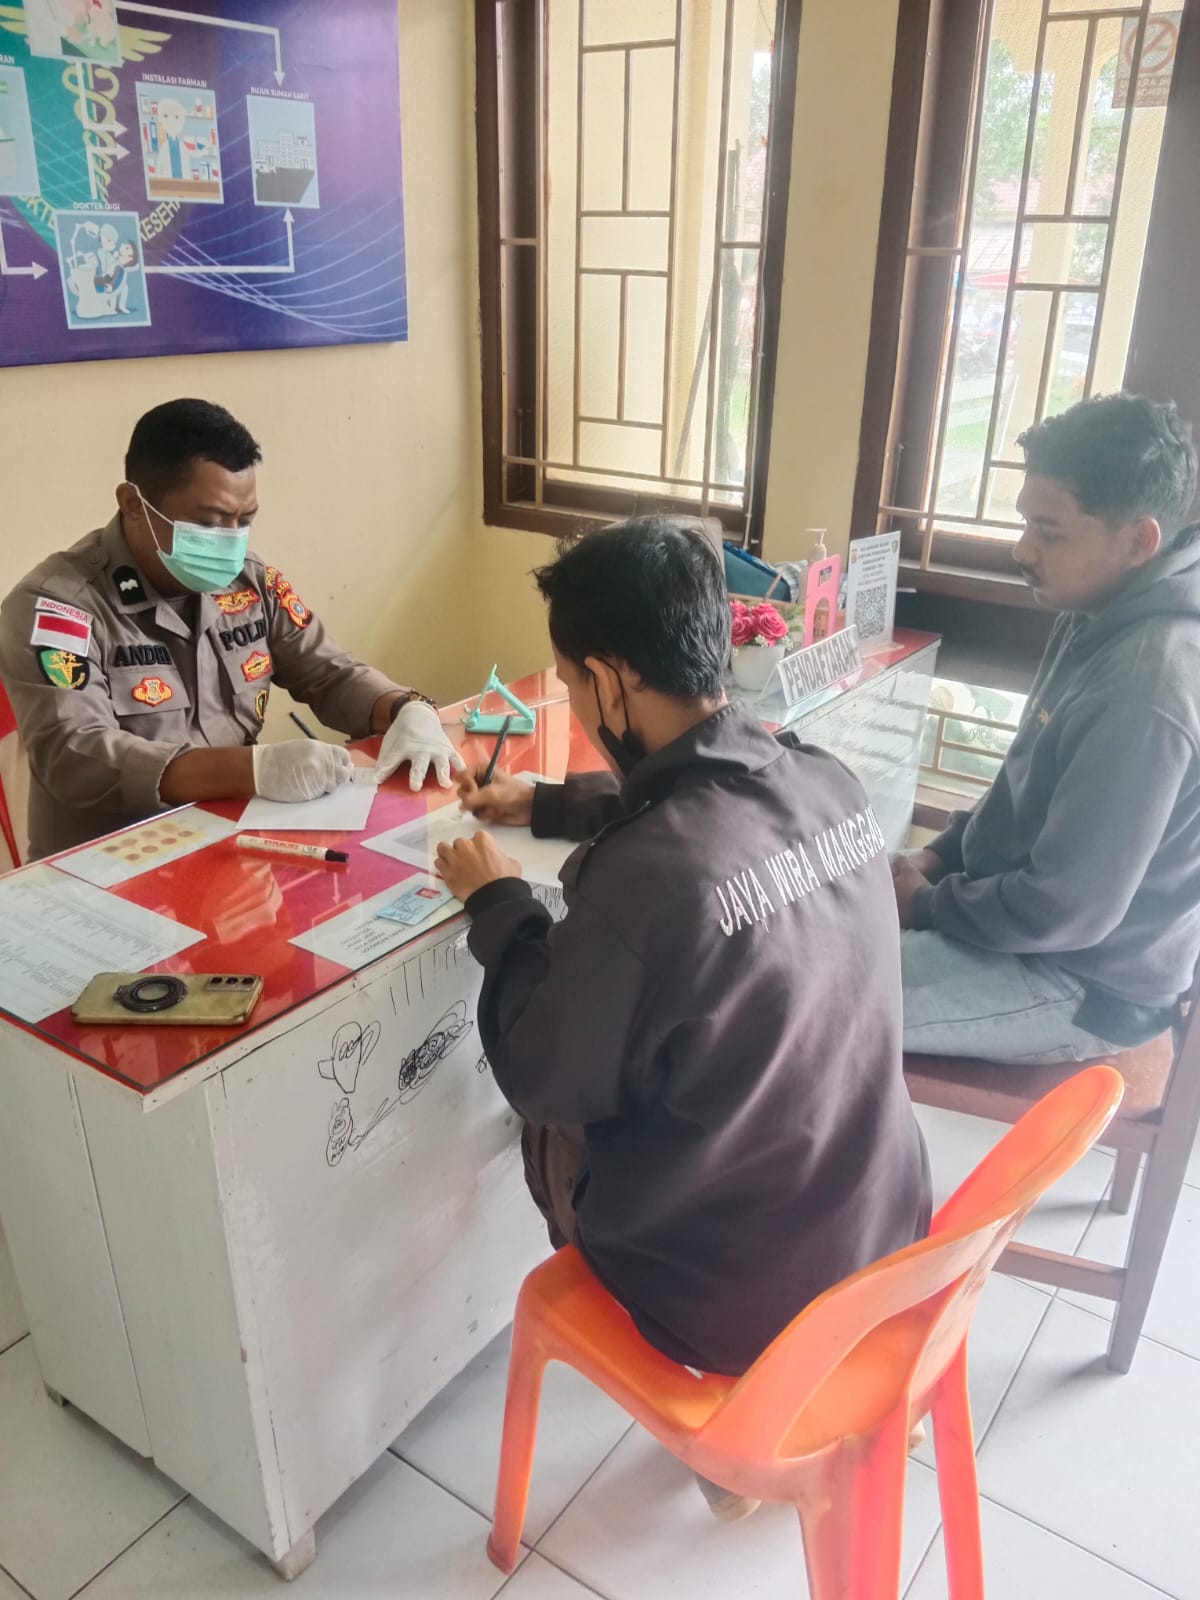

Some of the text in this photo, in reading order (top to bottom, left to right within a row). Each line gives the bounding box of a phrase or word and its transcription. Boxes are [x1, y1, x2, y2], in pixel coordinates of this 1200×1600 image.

[142, 73, 207, 88] INSTALASI FARMASI
[40, 600, 89, 623] INDONESIA
[782, 629, 858, 701] PENDAFTARAN
[716, 867, 775, 937] JAYA
[765, 842, 821, 906] WIRA
